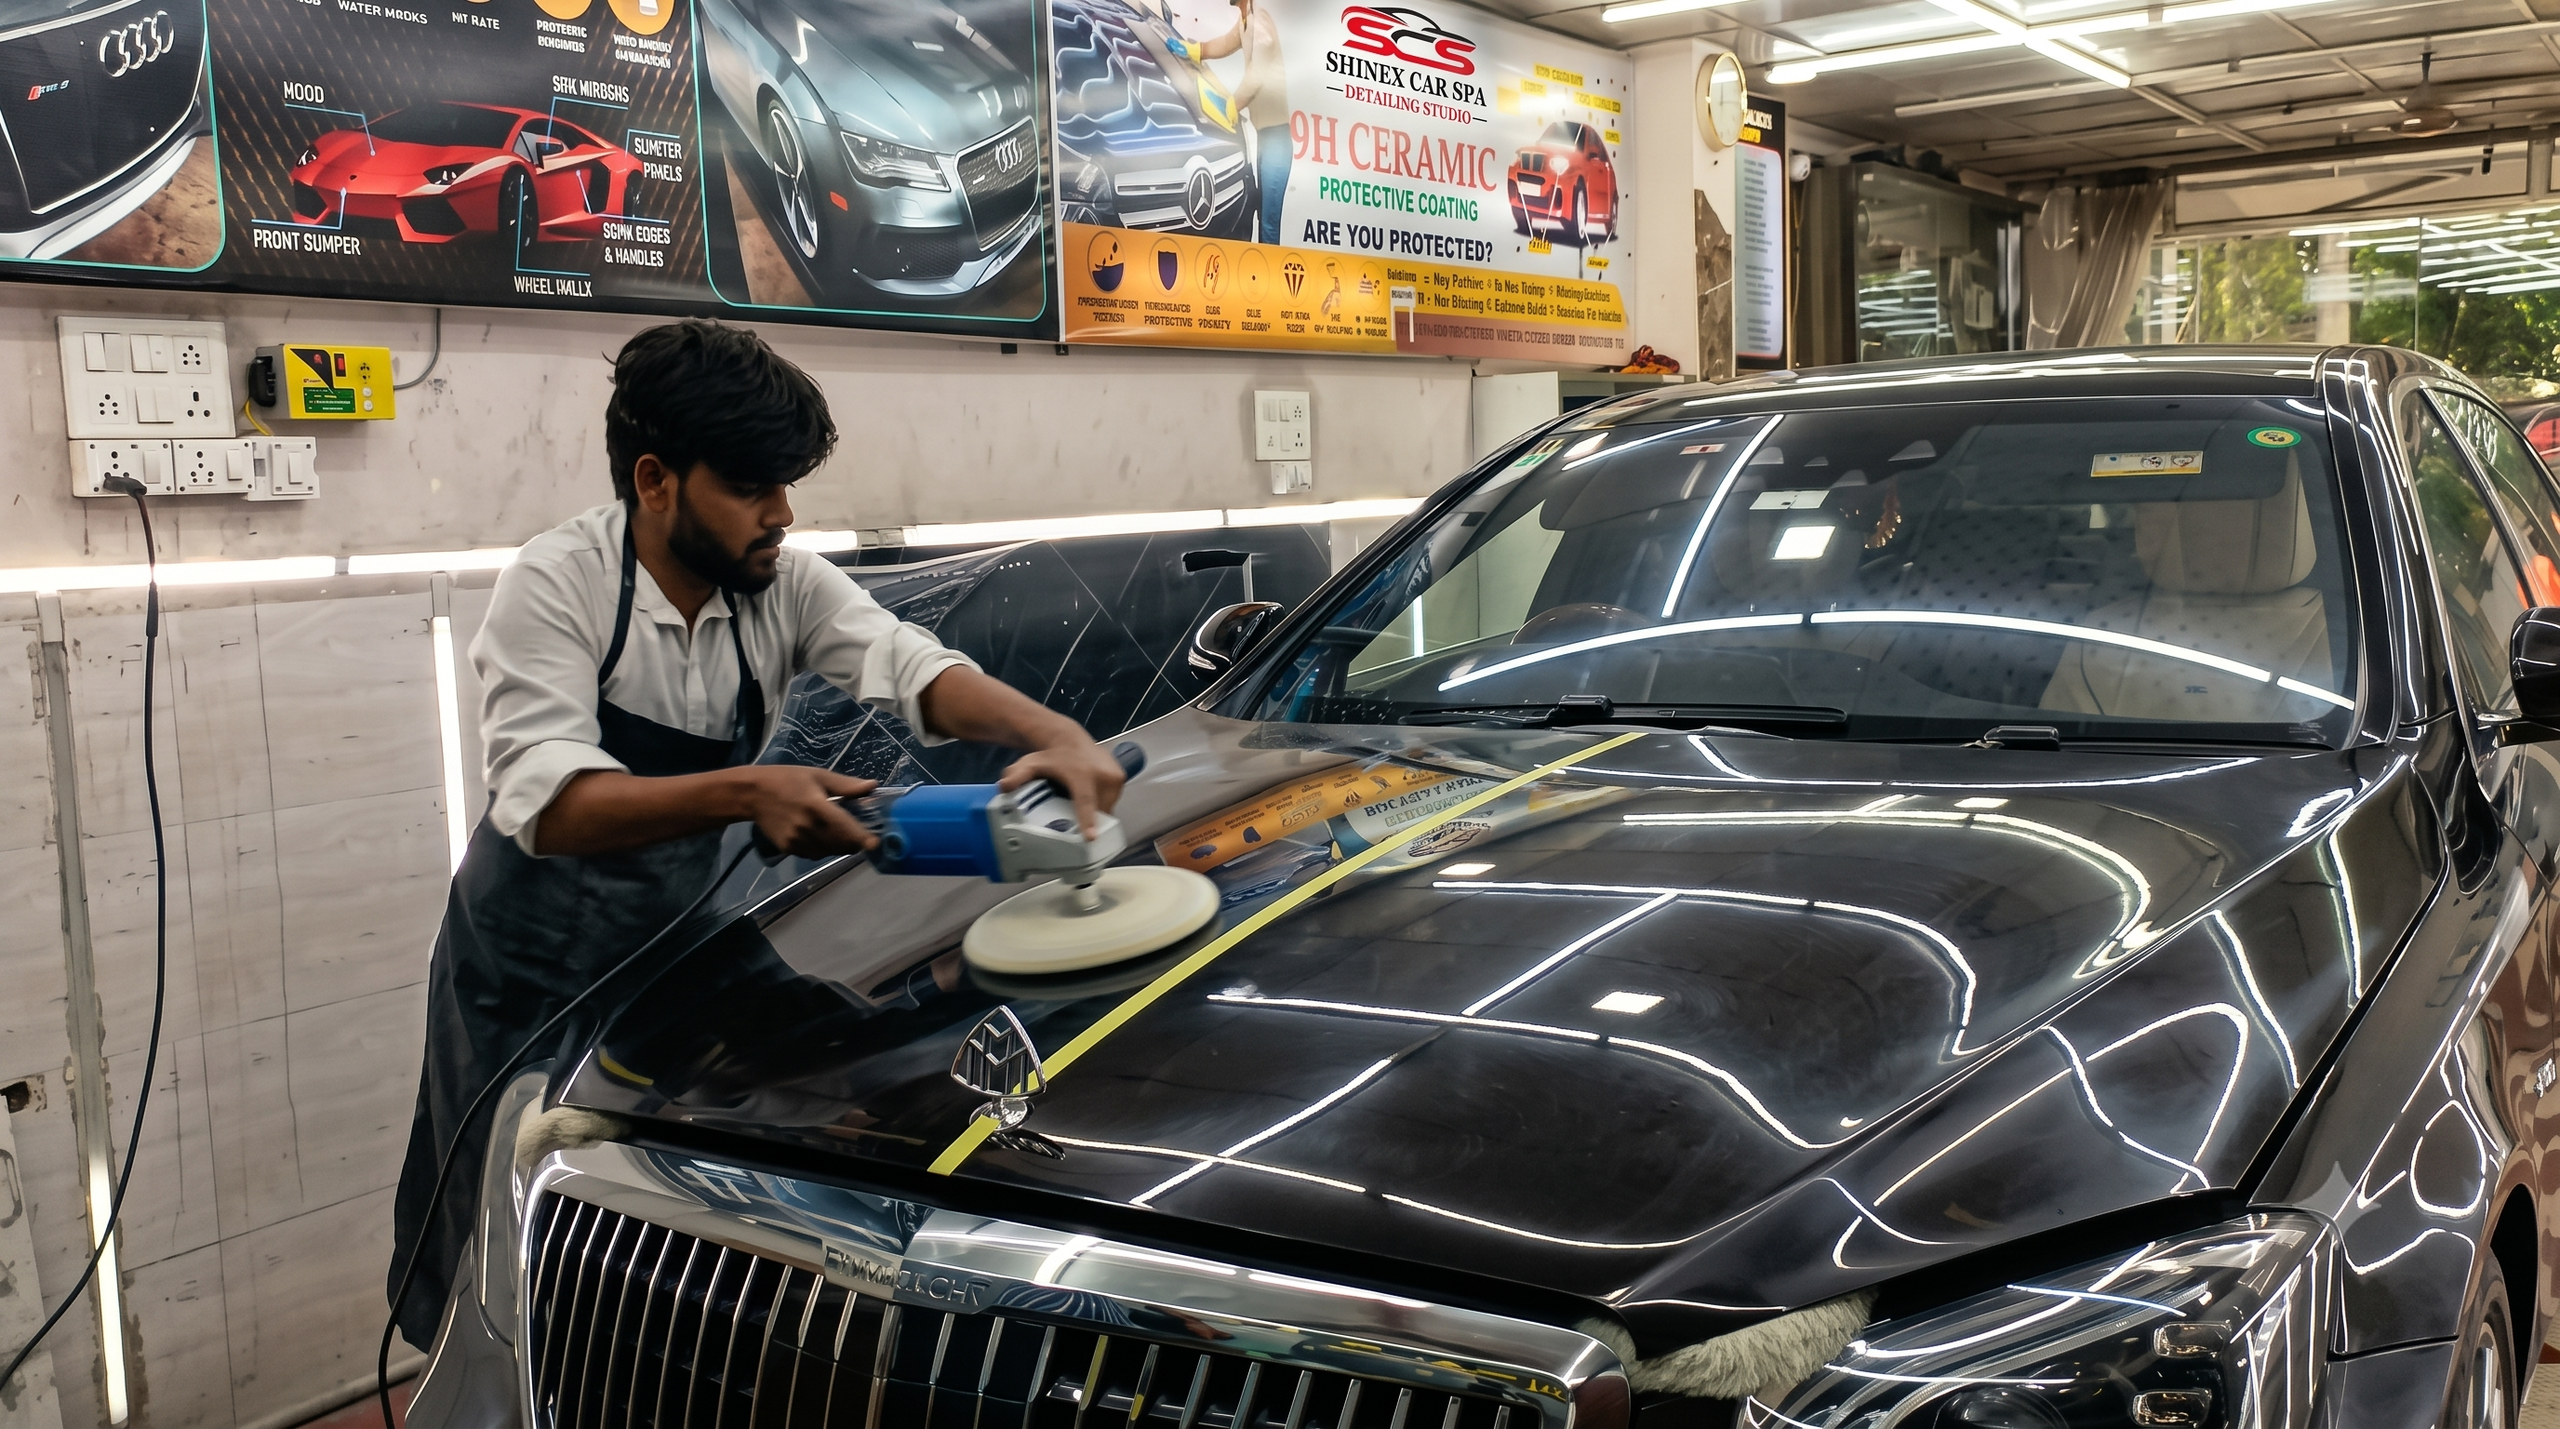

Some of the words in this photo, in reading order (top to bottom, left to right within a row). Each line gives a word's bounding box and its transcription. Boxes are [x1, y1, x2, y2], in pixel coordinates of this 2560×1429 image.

[337, 0, 382, 17] WATER
[471, 15, 500, 30] RATE
[283, 81, 325, 104] MOOD
[1326, 51, 1405, 88] SHINEX
[1410, 71, 1449, 98] CAR
[1452, 81, 1487, 107] SPA
[1345, 84, 1420, 114] DETAILING
[1422, 101, 1471, 125] STUDIO
[1290, 110, 1339, 165] 9H
[1349, 122, 1497, 192] CERAMIC
[1319, 176, 1414, 213] PROTECTIVE
[1418, 192, 1478, 221] COATING
[253, 228, 300, 250] PRONT
[303, 232, 361, 256] SUMPER
[604, 246, 614, 263] &
[1303, 218, 1341, 246] ARE
[1346, 223, 1383, 250] YOU
[1389, 229, 1493, 263] PROTECTED?
[513, 275, 555, 295] WHEEL
